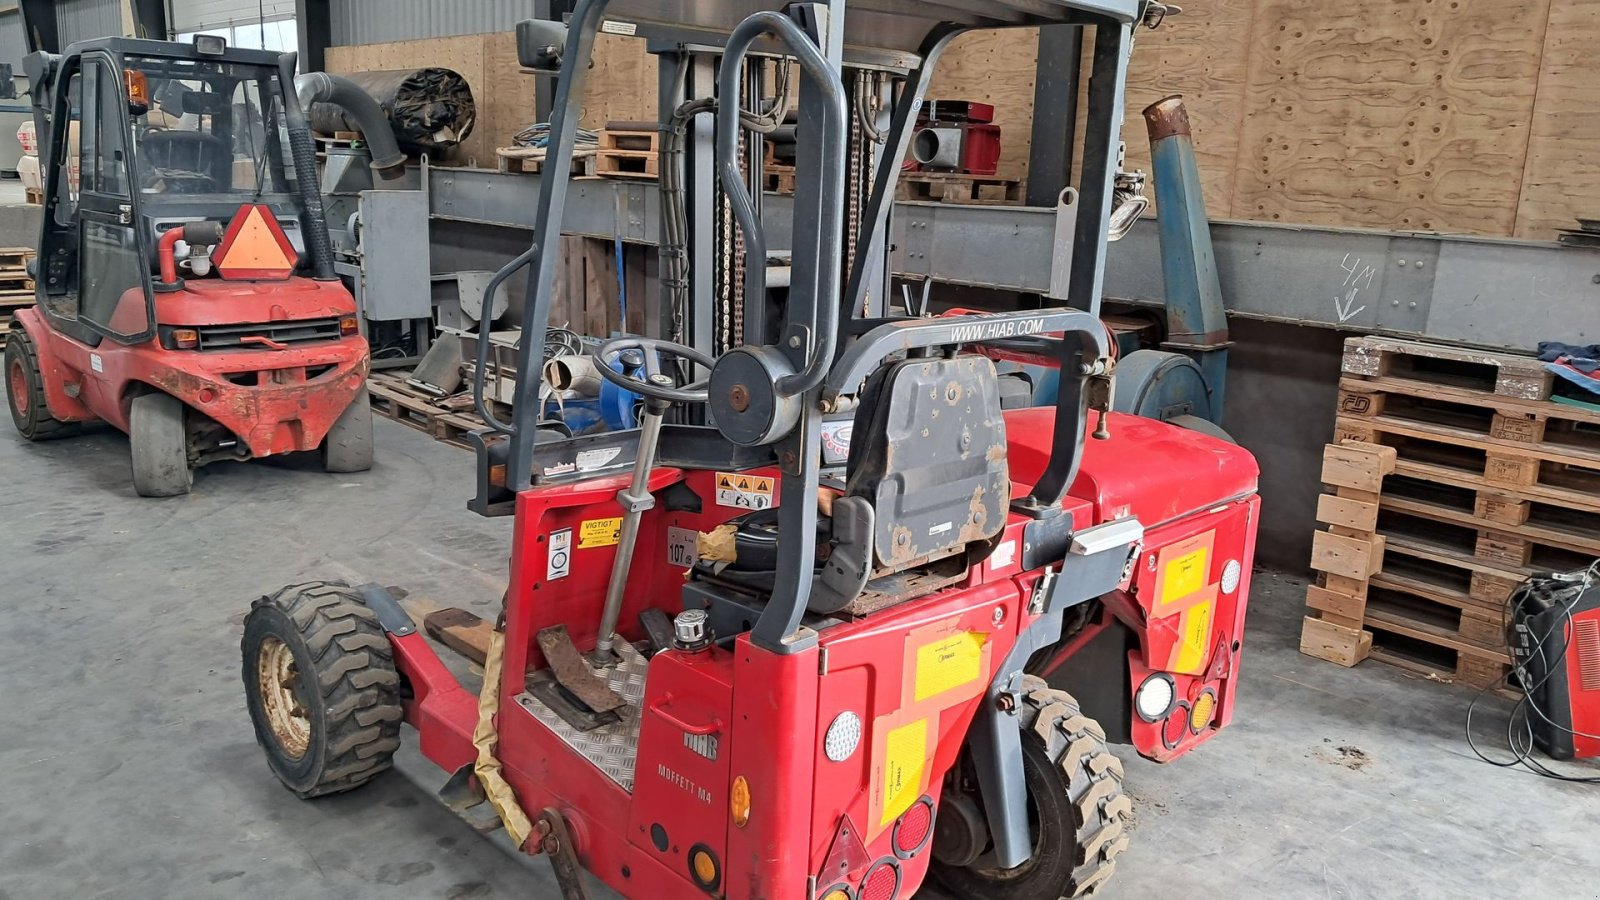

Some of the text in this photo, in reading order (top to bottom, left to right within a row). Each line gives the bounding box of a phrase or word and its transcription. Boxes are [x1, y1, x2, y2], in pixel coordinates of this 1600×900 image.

[950, 318, 1044, 342] WWW.HIAB.COM
[585, 520, 613, 529] VIGTIGT
[669, 544, 685, 563] 107
[658, 763, 712, 805] MOFFETT M4
